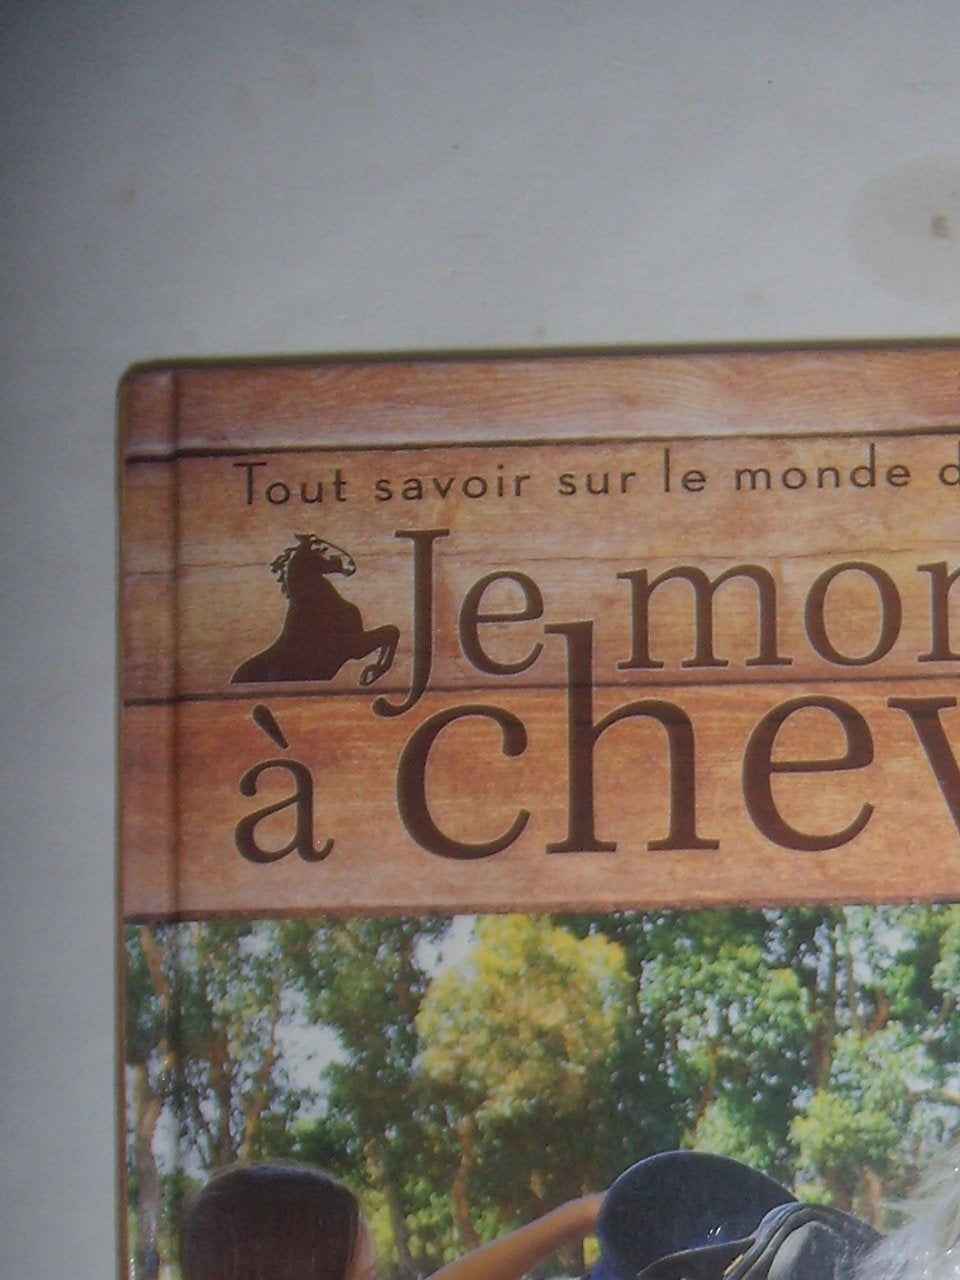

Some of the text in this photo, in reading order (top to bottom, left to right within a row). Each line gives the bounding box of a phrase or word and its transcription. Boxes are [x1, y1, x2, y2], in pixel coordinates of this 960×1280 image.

[232, 461, 348, 506] Tout
[373, 463, 532, 502] savoir
[557, 468, 636, 497] sur
[663, 449, 706, 494] le
[734, 443, 912, 492] monde
[371, 528, 545, 717] Je
[232, 704, 335, 863] à
